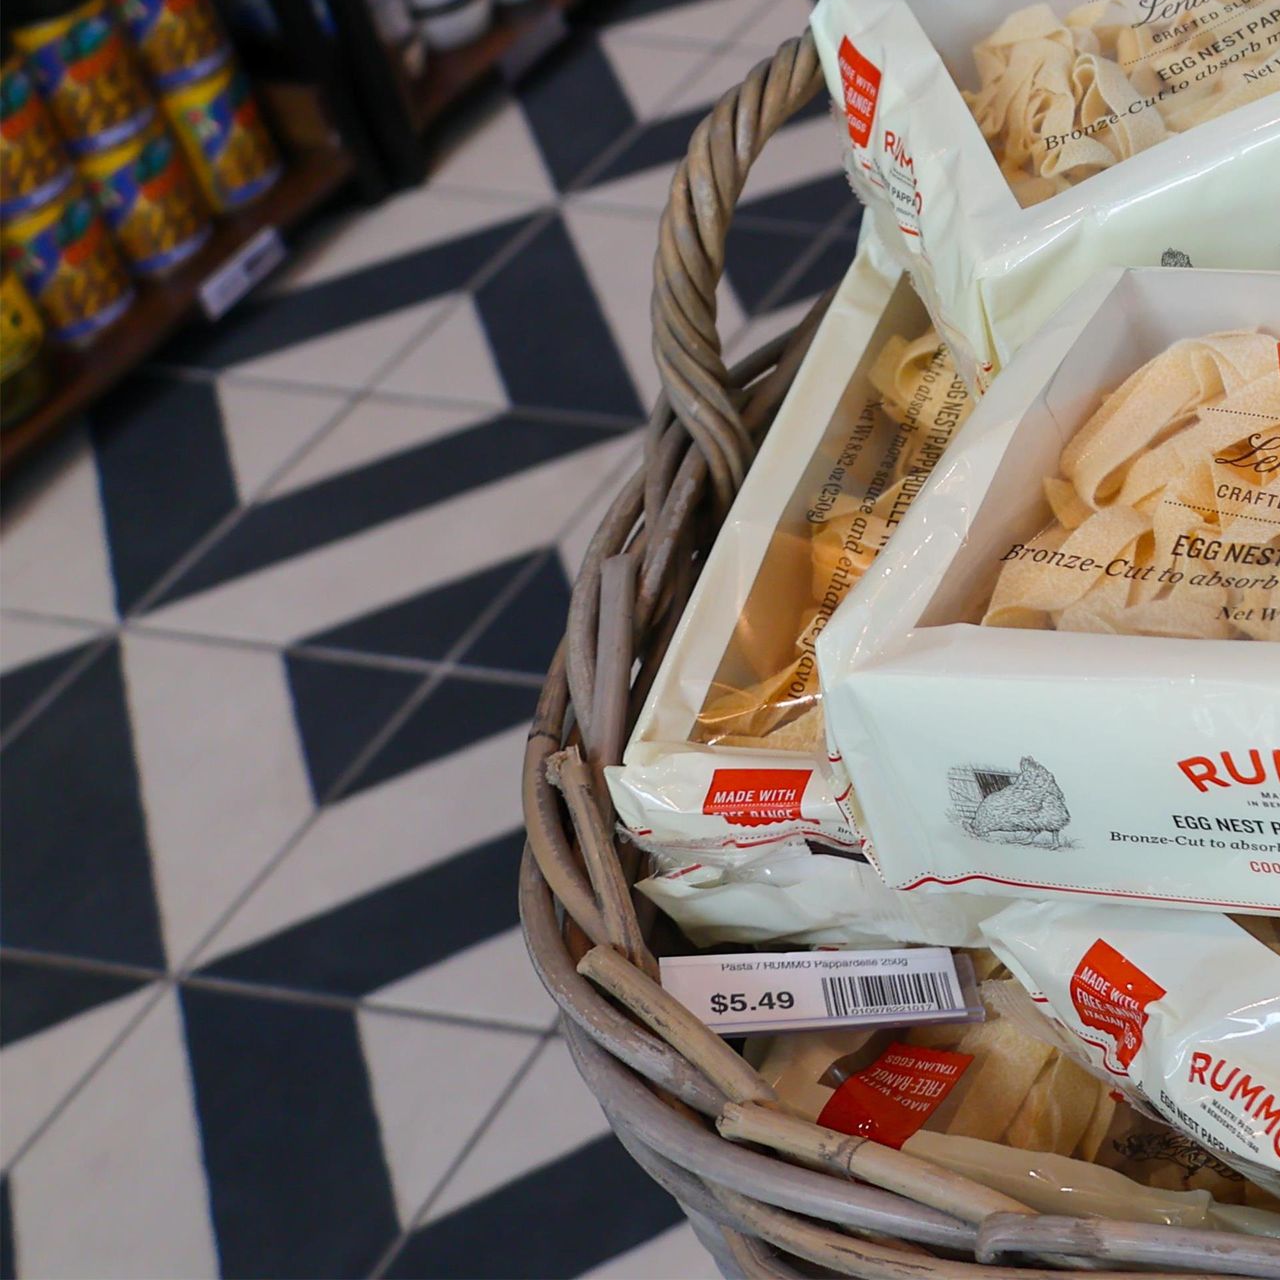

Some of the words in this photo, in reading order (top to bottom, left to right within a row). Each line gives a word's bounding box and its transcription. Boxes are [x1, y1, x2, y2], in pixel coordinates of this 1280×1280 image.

[1158, 56, 1197, 81] EGG
[1198, 27, 1252, 65] NEST
[1242, 65, 1273, 83] Net
[1171, 534, 1219, 561] EGG
[1000, 544, 1152, 582] Bronze-Cut
[1158, 569, 1185, 584] to
[1189, 571, 1279, 591] absorb
[1216, 605, 1254, 620] Net
[714, 791, 755, 803] MADE
[760, 789, 796, 801] WITH
[1172, 815, 1211, 831] EGG
[1215, 818, 1264, 834] NEST
[1110, 831, 1205, 848] Bronze-Cut
[1210, 838, 1226, 848] to
[721, 962, 752, 971] Pasta
[814, 959, 878, 968] Pappardelle
[710, 991, 795, 1014] $5.49
